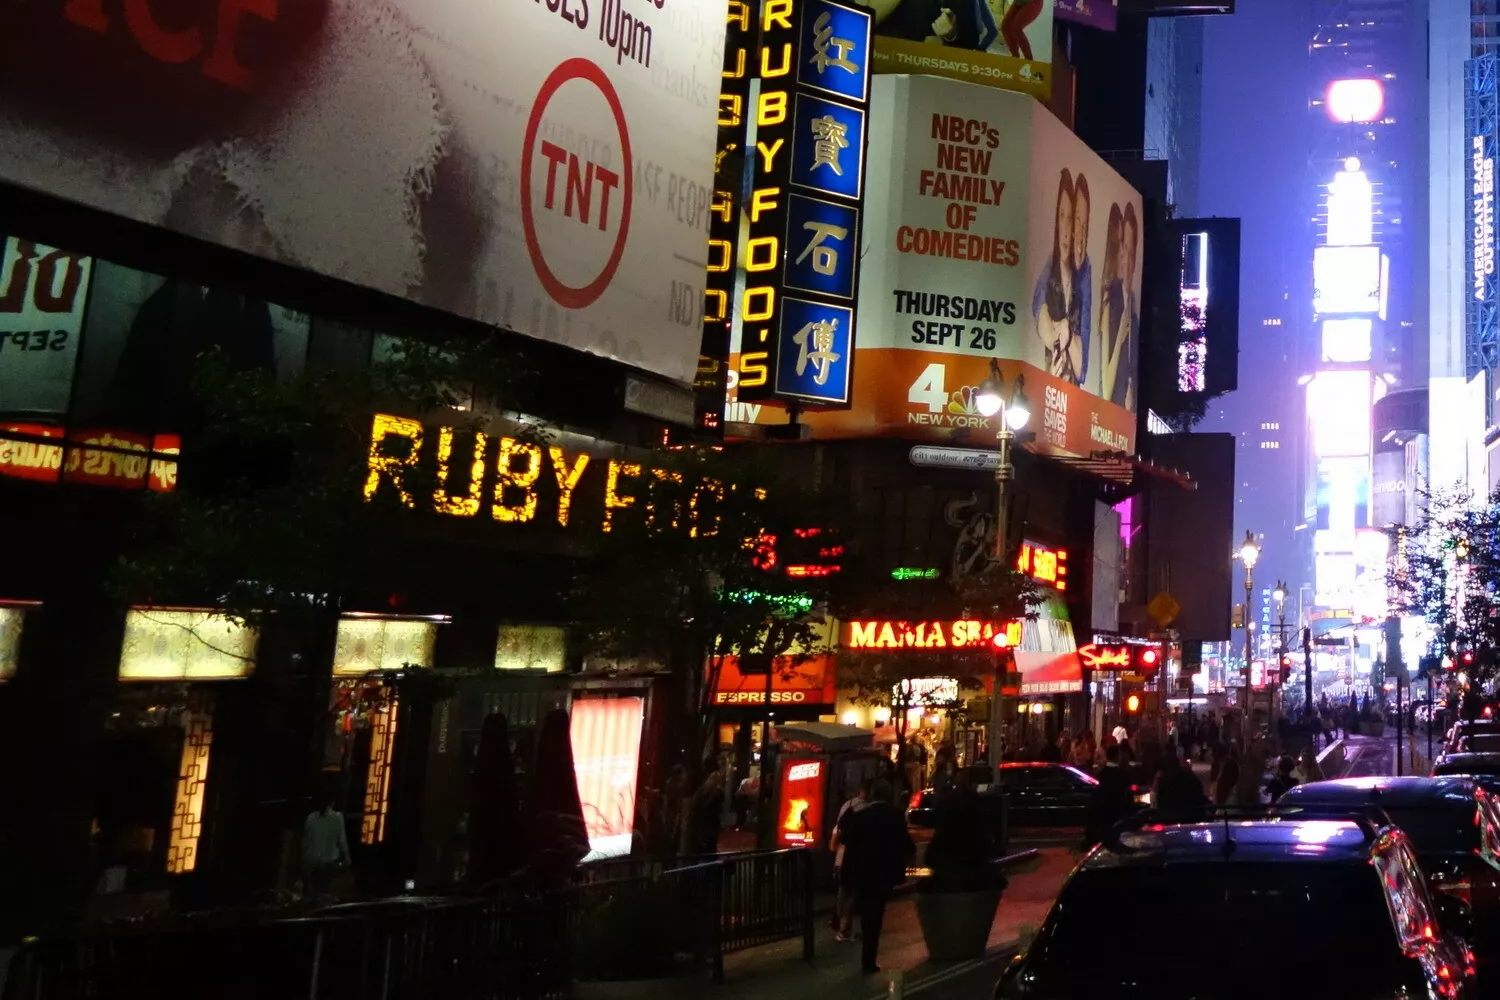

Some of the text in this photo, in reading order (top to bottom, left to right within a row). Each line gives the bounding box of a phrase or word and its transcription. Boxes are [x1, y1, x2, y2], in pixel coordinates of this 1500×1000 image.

[896, 52, 969, 72] THURSDAYS
[1019, 63, 1033, 79] 4
[931, 113, 999, 149] NBC's
[937, 143, 992, 175] NEW
[541, 140, 619, 232] TNT
[919, 170, 1005, 206] FAMILY
[946, 202, 977, 230] OF
[1473, 134, 1485, 301] AMERICAN EAGLE
[1484, 157, 1495, 274] OUTFITTERS
[896, 225, 1020, 267] COMEDIES
[893, 290, 1016, 325] THURSDAYS
[911, 320, 996, 351] SEPT 26
[908, 362, 949, 413] 4
[1045, 385, 1067, 414] SEAN
[908, 411, 989, 429] NEW YORK
[1044, 409, 1067, 433] SAVES
[1090, 423, 1113, 447] MICHAEL
[716, 691, 805, 704] ESPRESSO
